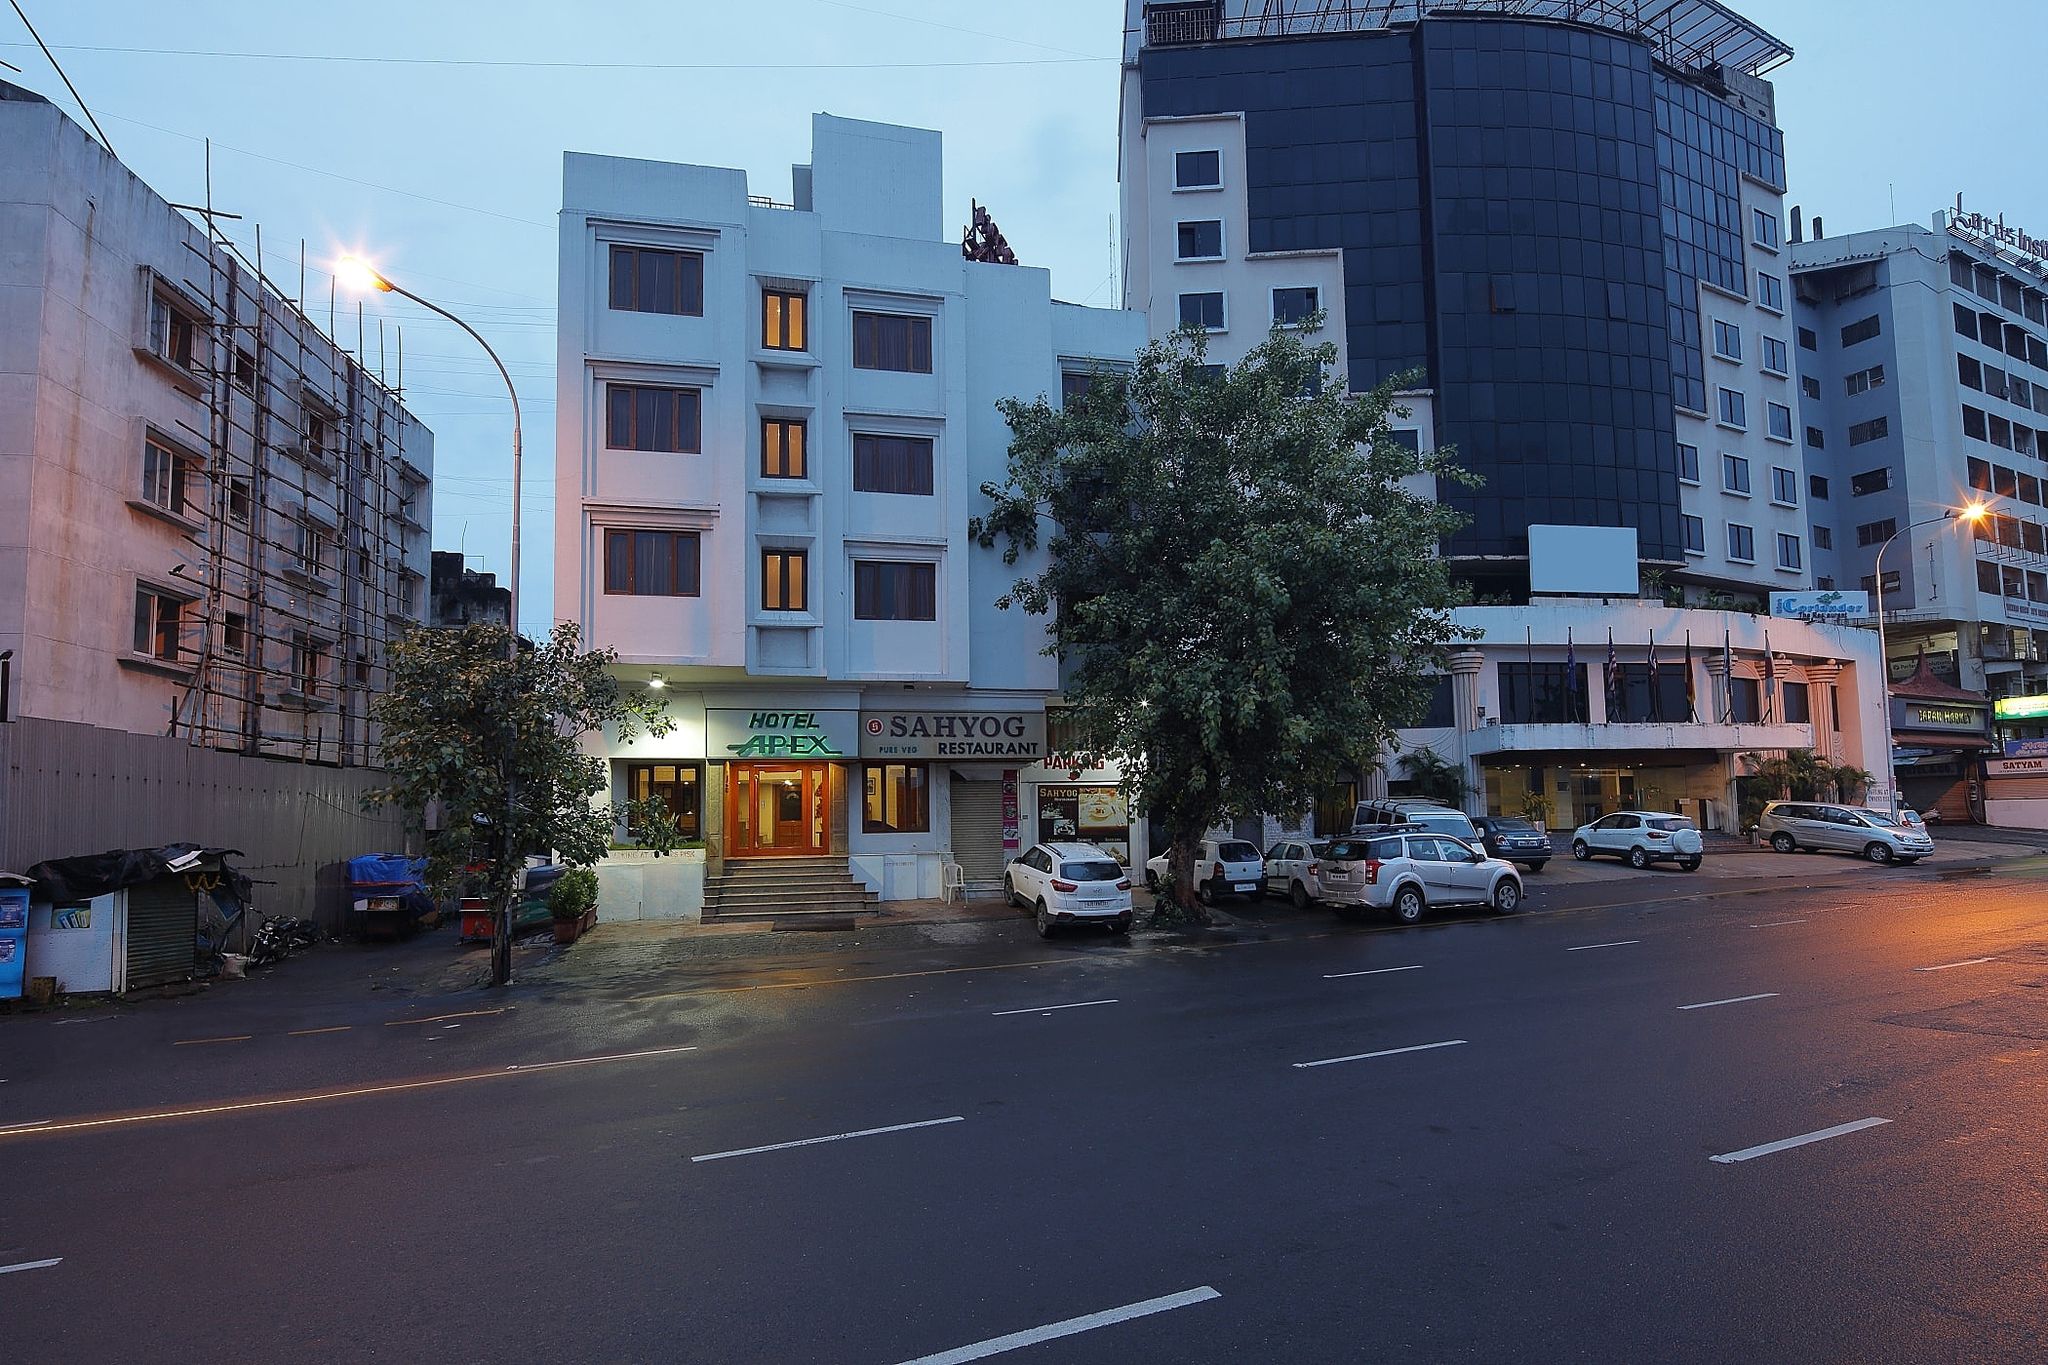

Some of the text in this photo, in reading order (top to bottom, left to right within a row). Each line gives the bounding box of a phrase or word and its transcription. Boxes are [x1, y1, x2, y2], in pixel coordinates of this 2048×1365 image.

[749, 712, 820, 729] HOTEL
[890, 715, 1025, 738] SAHYOG
[726, 734, 843, 758] APEX
[879, 746, 918, 754] PURE VEG
[938, 742, 1039, 755] RESTAURANT
[2002, 760, 2043, 770] SATYAM
[1039, 788, 1078, 798] SAHYOG
